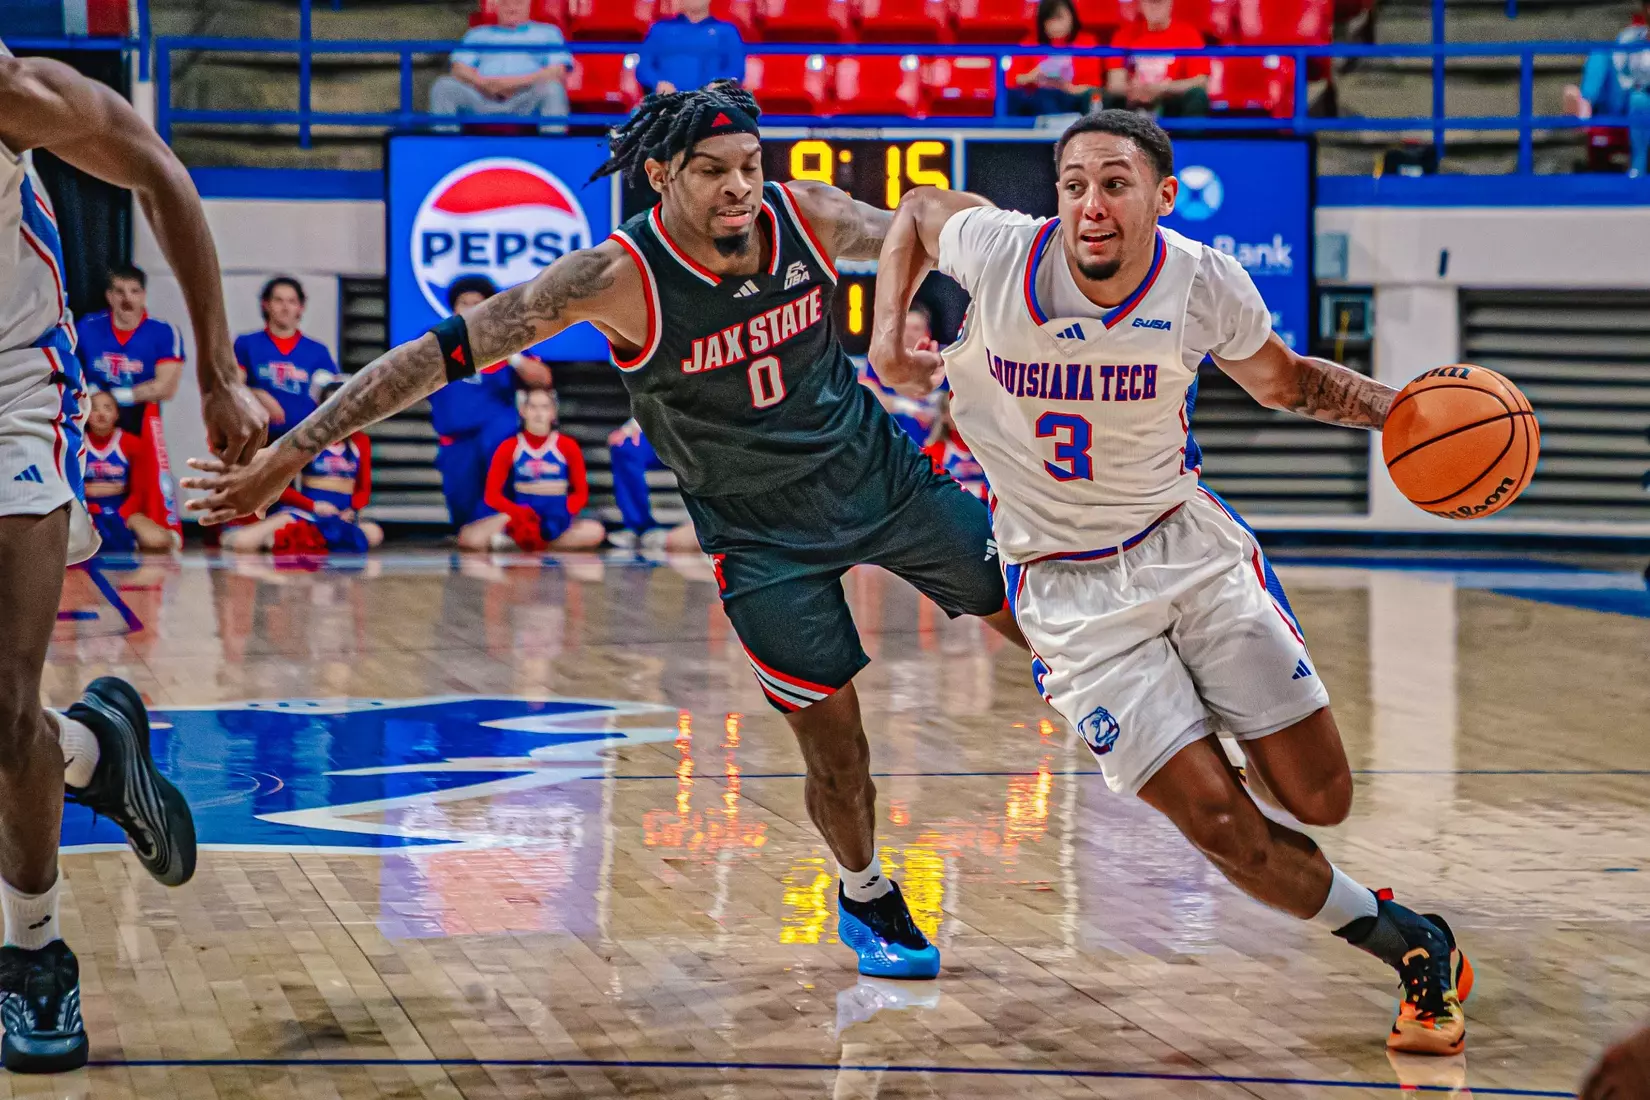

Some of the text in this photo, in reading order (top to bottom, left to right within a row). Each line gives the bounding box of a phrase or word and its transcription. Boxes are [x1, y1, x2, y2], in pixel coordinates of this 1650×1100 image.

[421, 231, 583, 267] PEPSI
[681, 284, 823, 375] JAX STATE
[747, 354, 788, 411] 0
[986, 346, 1158, 402] LOUISIANA TECH
[1035, 410, 1094, 482] 3
